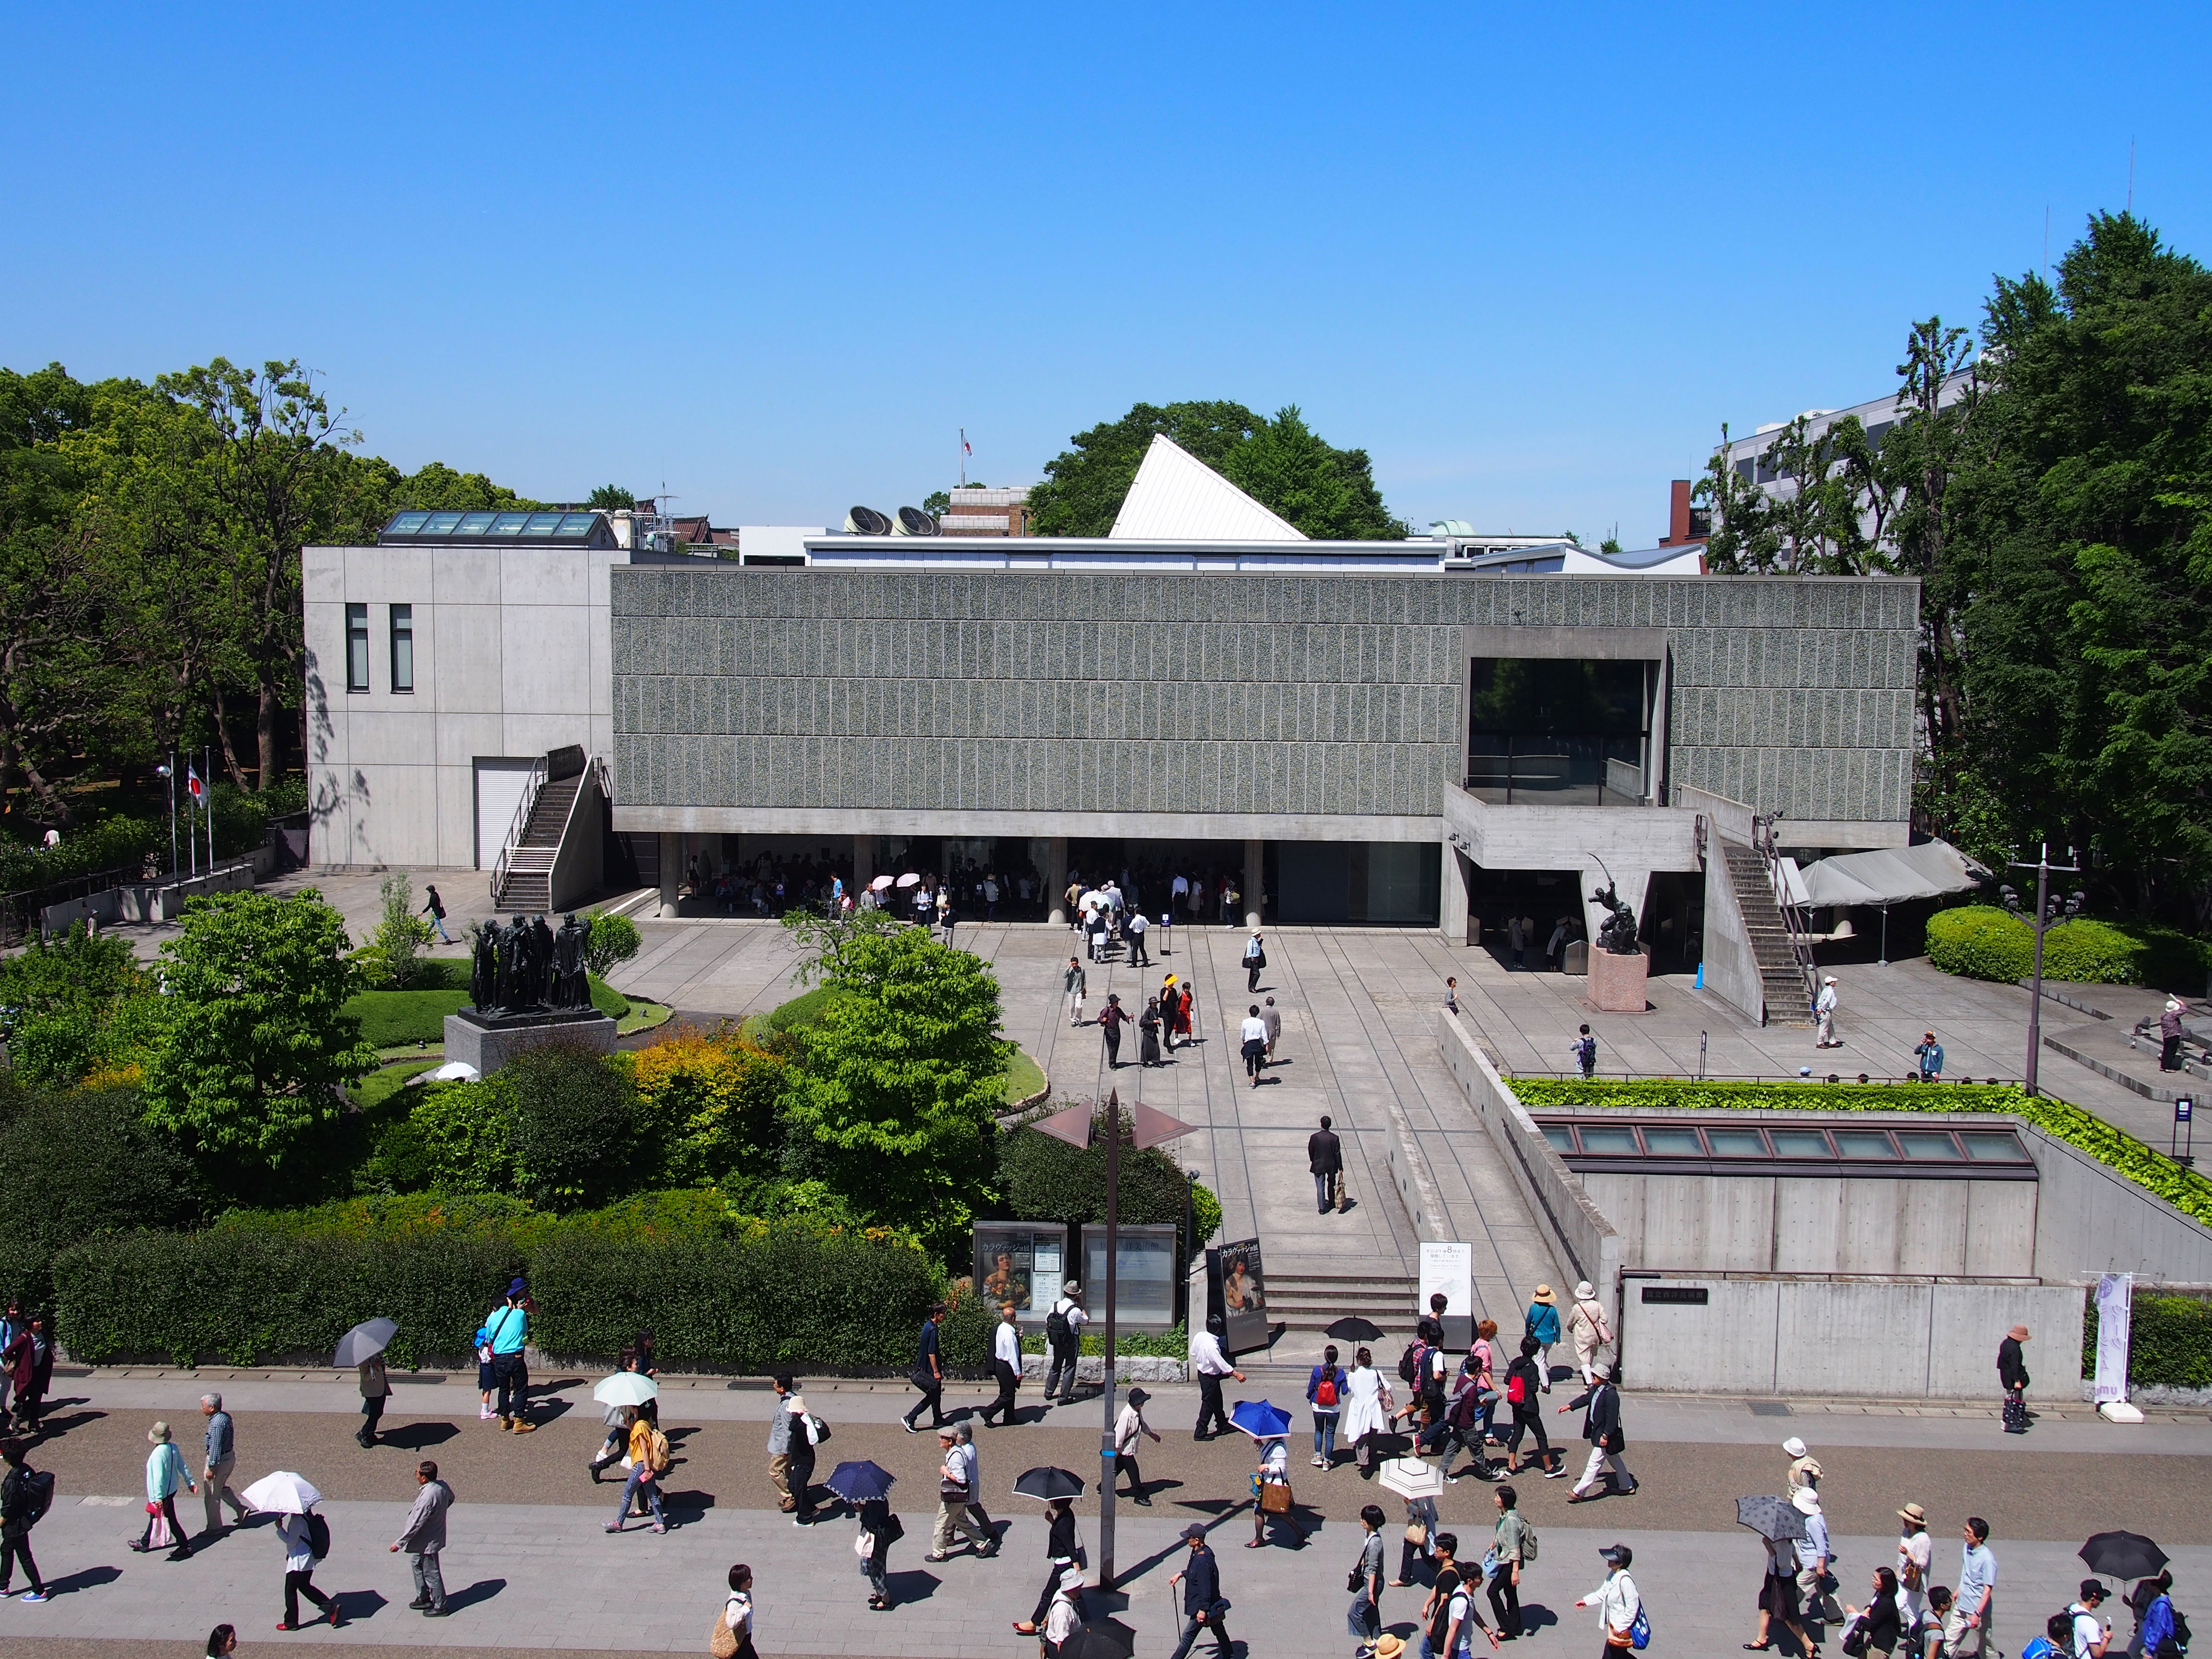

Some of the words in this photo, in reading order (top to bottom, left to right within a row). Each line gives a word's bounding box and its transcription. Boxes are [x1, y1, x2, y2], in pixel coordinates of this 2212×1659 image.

[981, 1242, 1031, 1252] カラヴァッジョ展
[1222, 1244, 1258, 1258] カラヴァッジョ展
[1646, 1290, 1704, 1298] 国立西洋美術館
